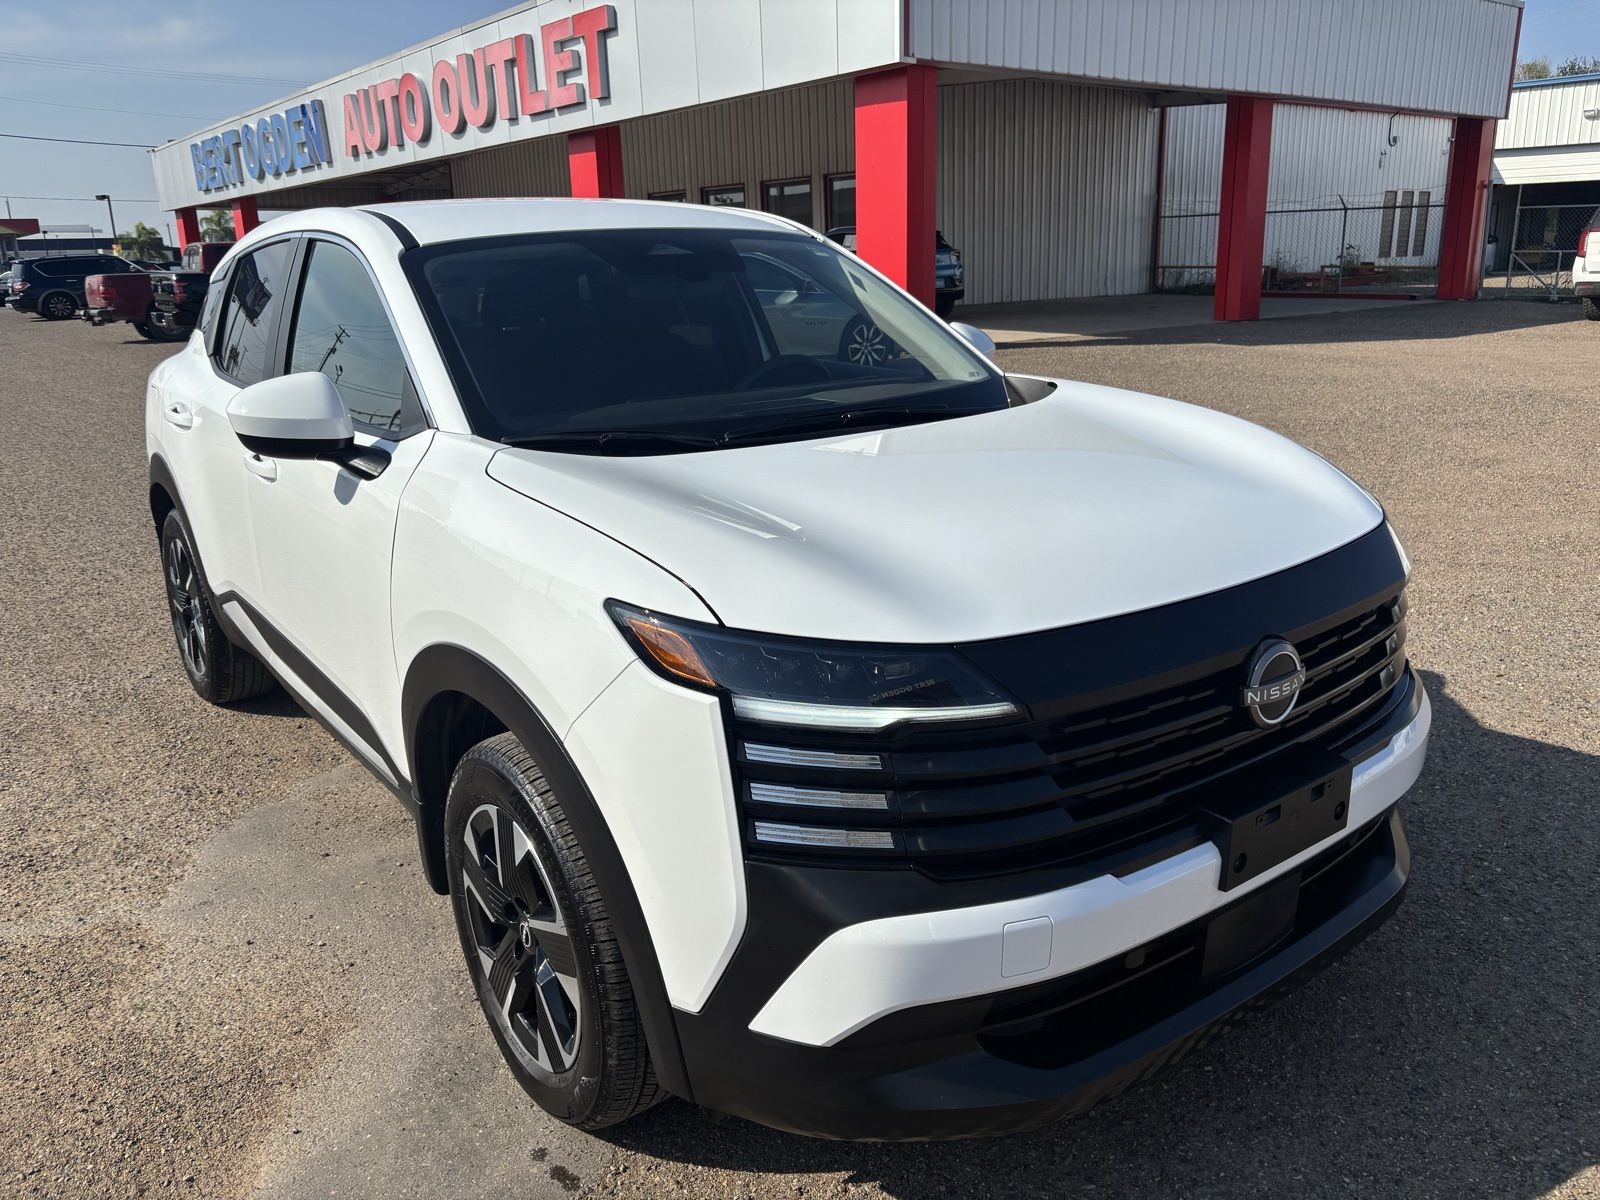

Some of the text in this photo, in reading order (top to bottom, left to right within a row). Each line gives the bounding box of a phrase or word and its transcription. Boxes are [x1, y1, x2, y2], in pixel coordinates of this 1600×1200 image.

[190, 4, 617, 192] BERT OGDEN AUTO OUTLET
